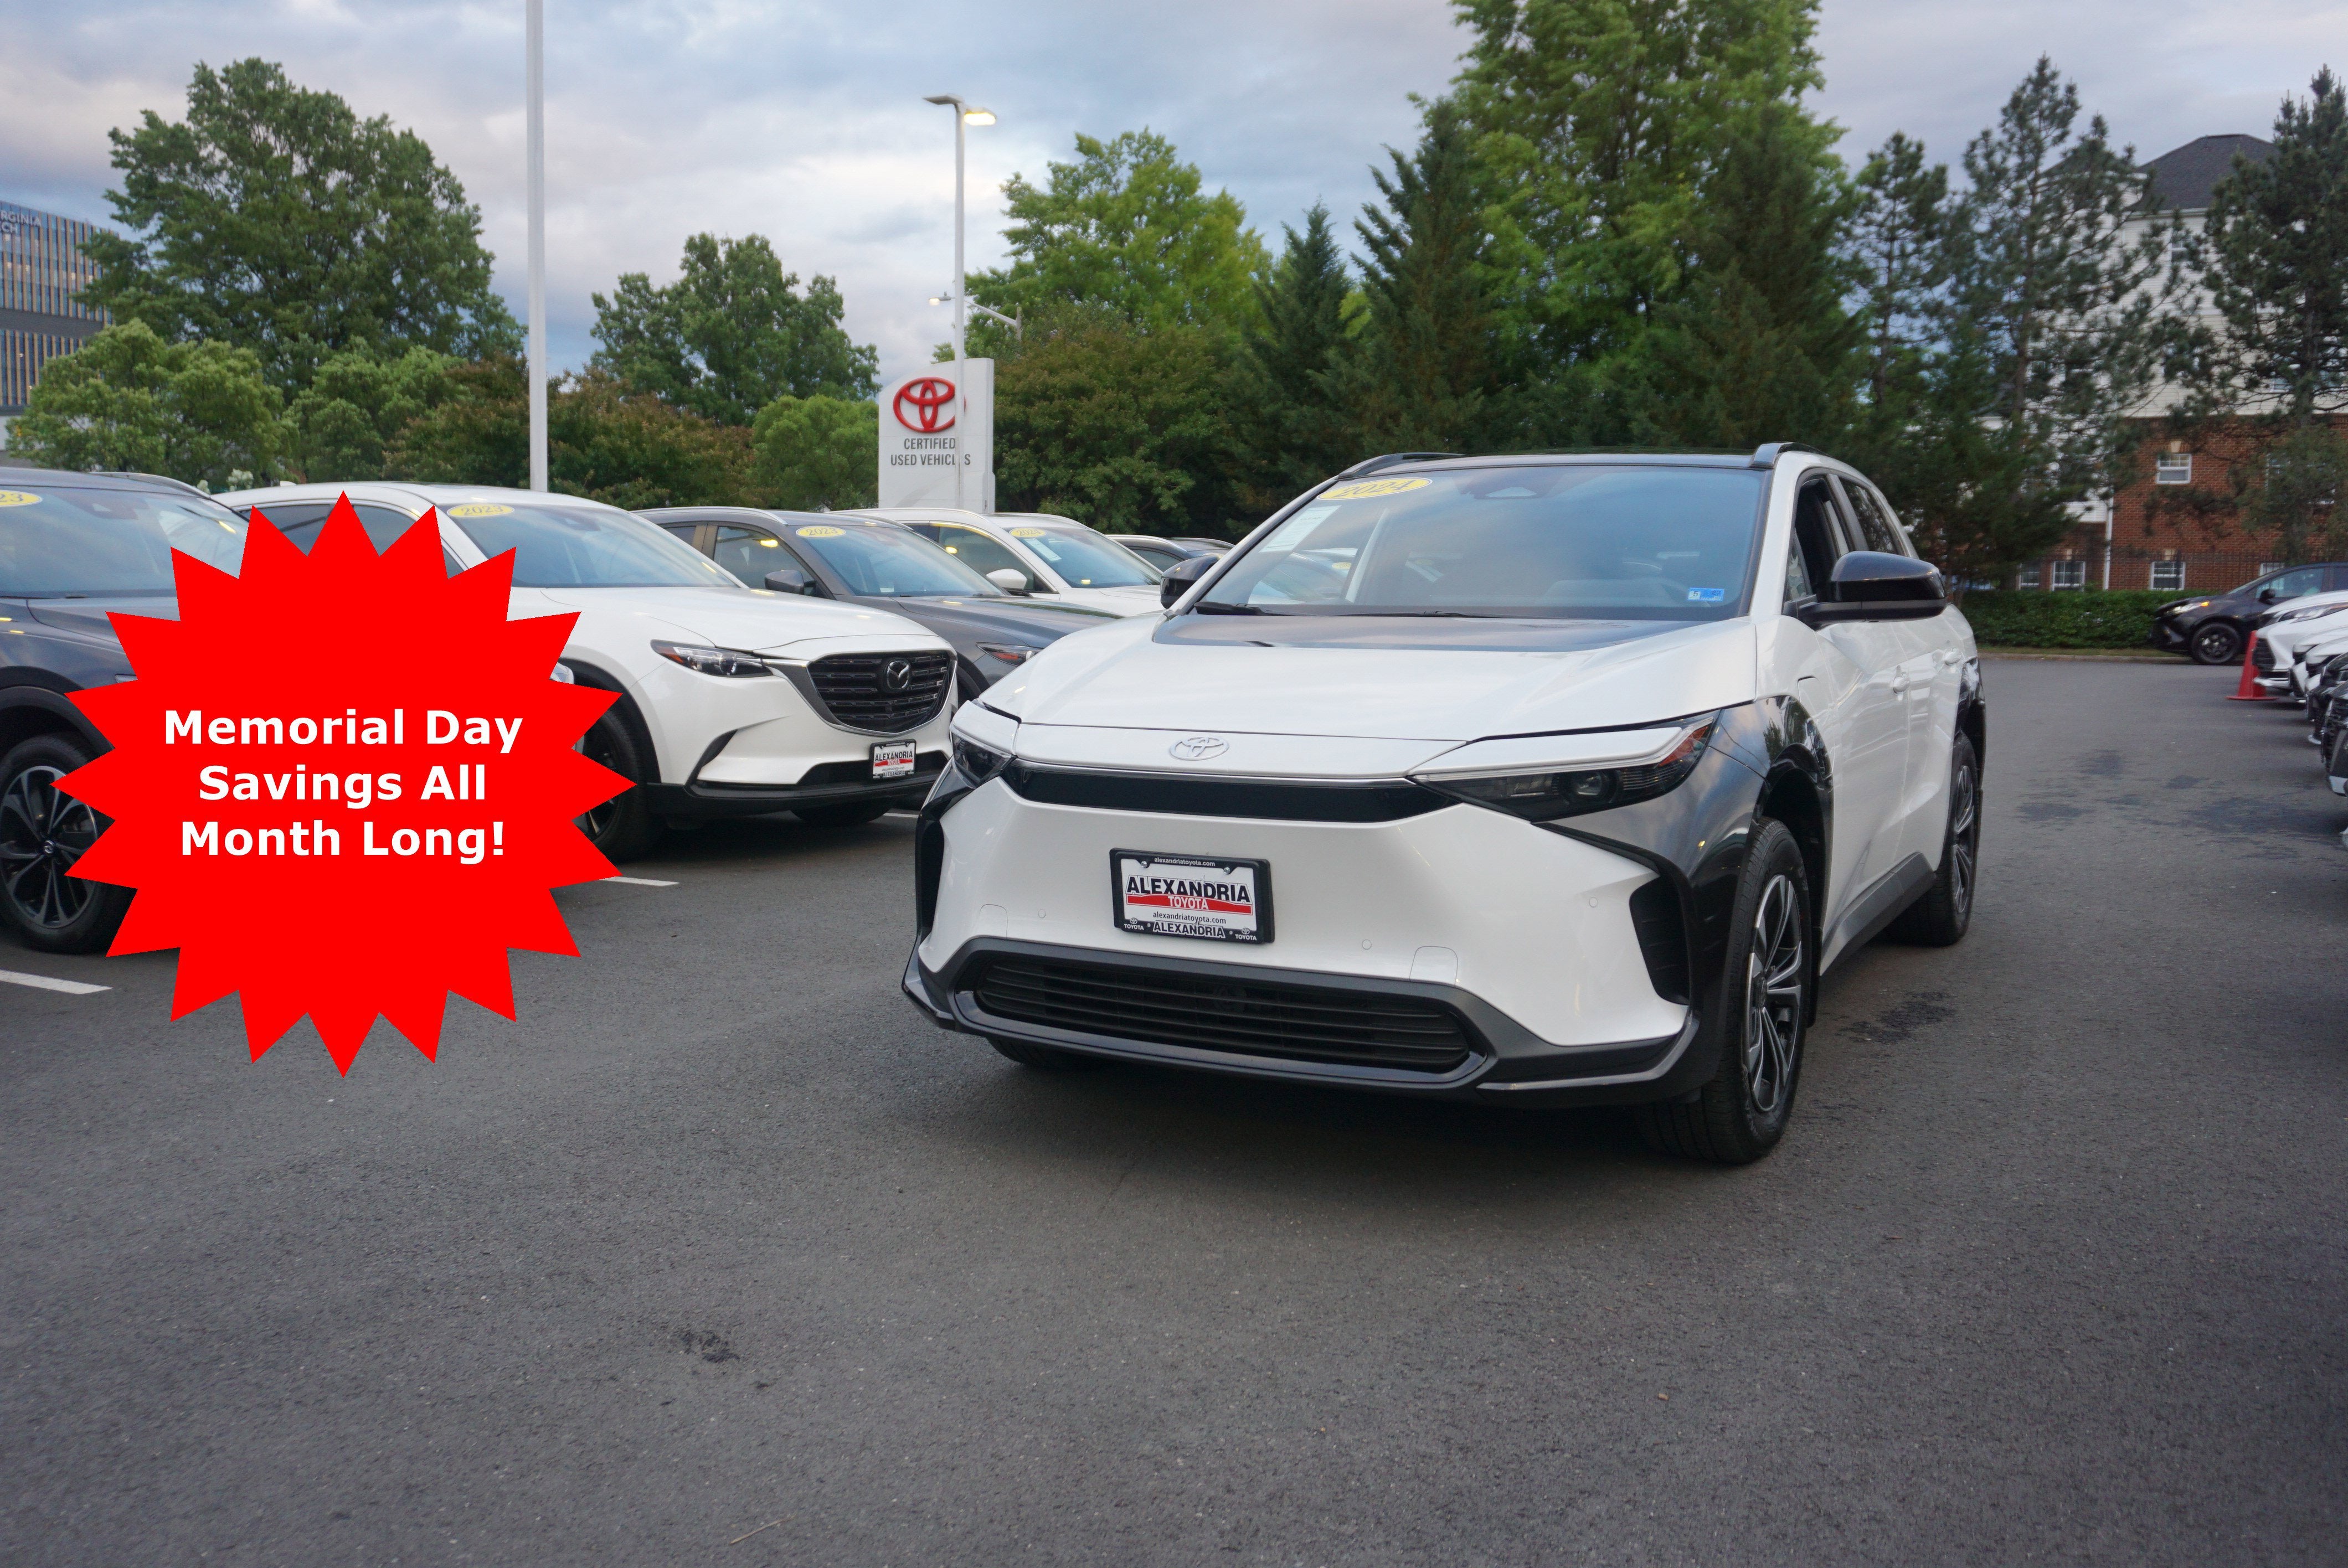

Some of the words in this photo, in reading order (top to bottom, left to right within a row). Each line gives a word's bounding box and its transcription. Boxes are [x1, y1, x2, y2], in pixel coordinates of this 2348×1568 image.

[1, 210, 41, 226] RGINIA
[904, 437, 955, 450] CERTIFIED
[890, 454, 917, 466] USED
[920, 453, 971, 466] VEHICLS
[1332, 479, 1417, 498] 2024
[0, 493, 23, 502] 23
[461, 505, 504, 516] 2023
[806, 527, 838, 536] 2023
[875, 750, 913, 762] ALEXANDRIA
[1154, 857, 1216, 866] alexandriatoyota.com
[1126, 876, 1251, 903] ALEXANDRIA
[1168, 896, 1209, 910] TOYOTA
[1153, 911, 1227, 925] alexandriatoyota.com
[1153, 921, 1226, 938] ALEXANDRIA
